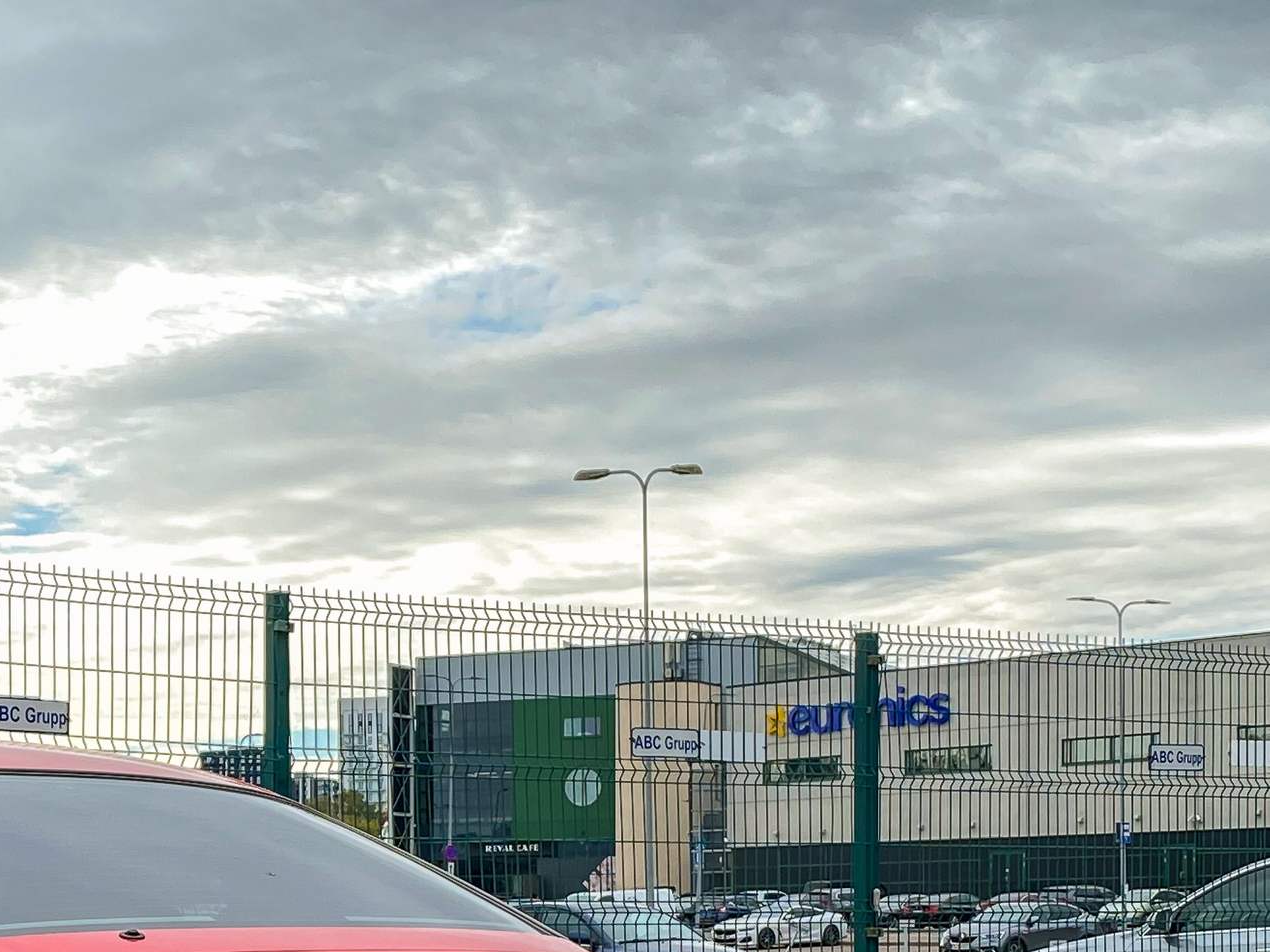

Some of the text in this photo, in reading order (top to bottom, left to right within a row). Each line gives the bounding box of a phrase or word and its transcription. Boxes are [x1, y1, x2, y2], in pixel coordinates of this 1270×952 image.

[25, 707, 67, 729] Grupp
[789, 685, 950, 736] eurnics
[634, 735, 698, 754] ABC Grupp
[1152, 750, 1203, 767] ABC Grupp
[485, 844, 514, 852] REVAL
